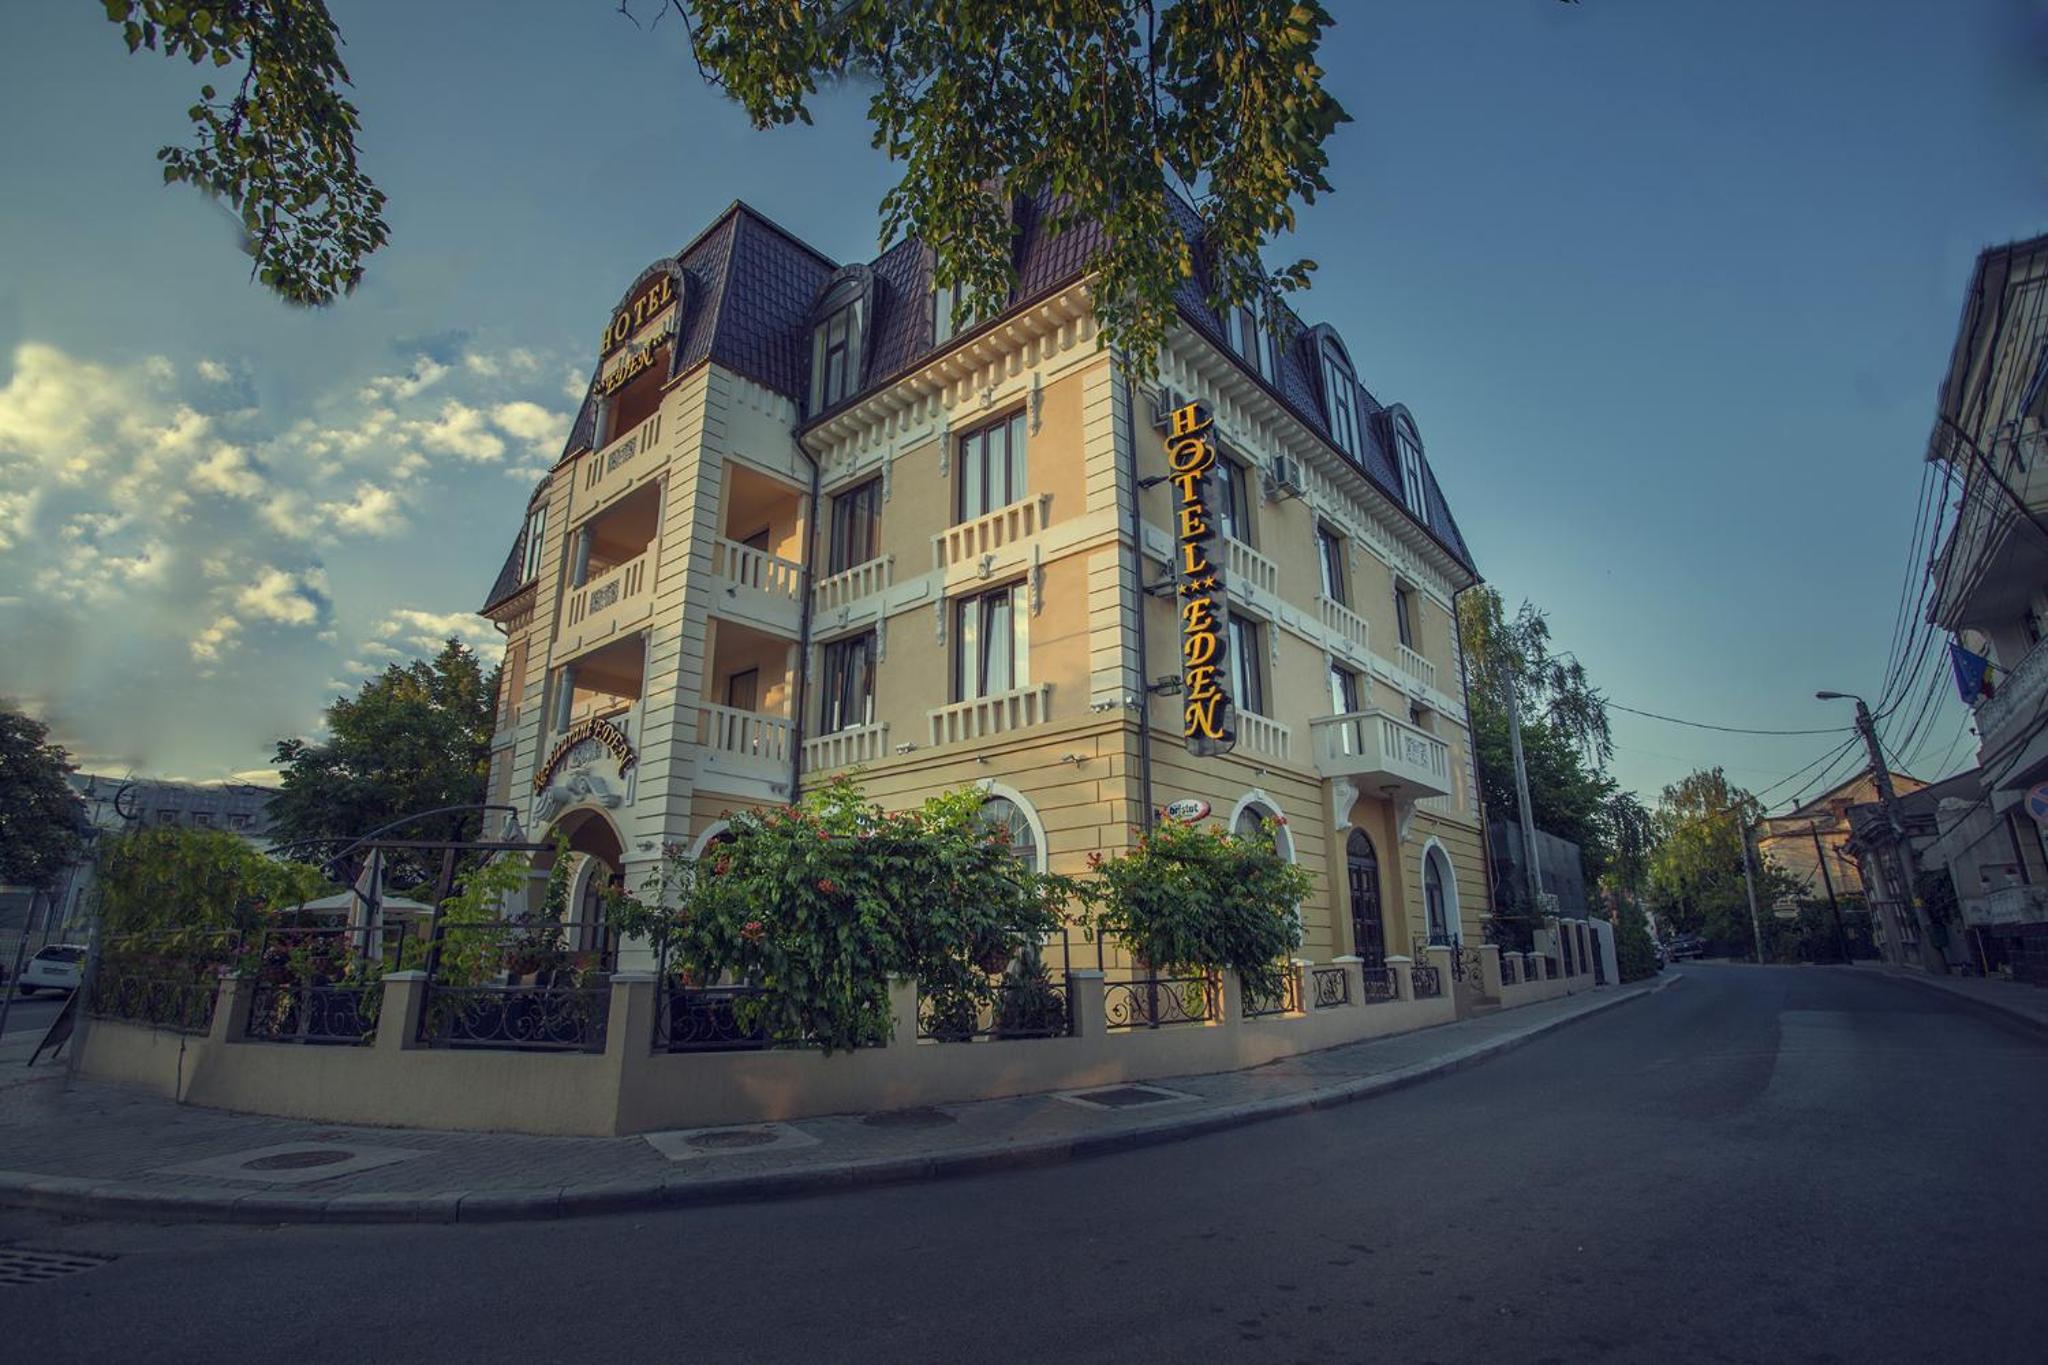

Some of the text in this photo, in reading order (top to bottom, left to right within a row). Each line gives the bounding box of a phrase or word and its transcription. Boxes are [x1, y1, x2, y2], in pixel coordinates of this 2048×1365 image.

[601, 275, 673, 353] HOTEL
[605, 347, 654, 396] EDEN
[1165, 402, 1225, 740] HOTEL EDEN
